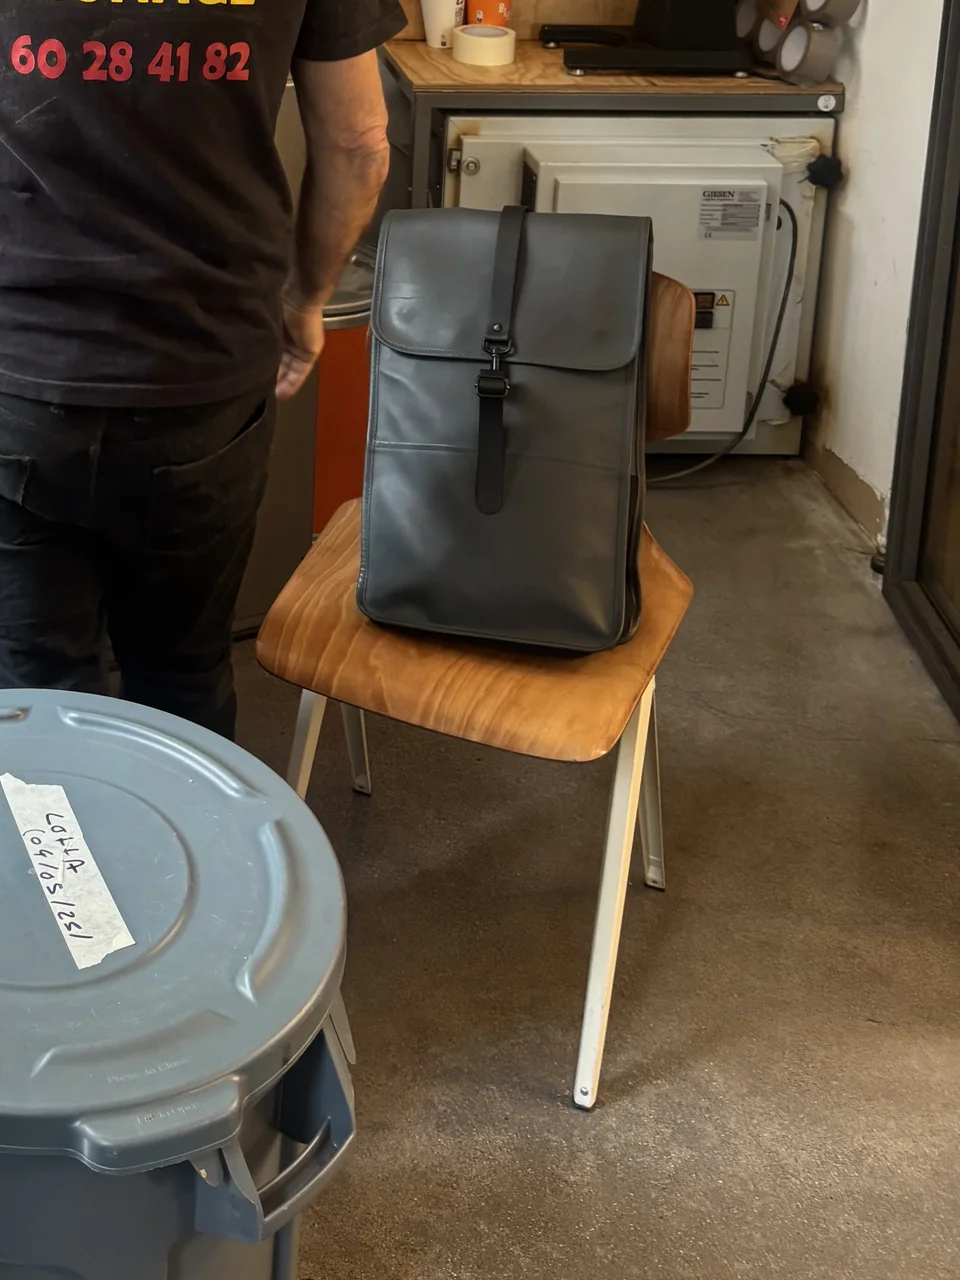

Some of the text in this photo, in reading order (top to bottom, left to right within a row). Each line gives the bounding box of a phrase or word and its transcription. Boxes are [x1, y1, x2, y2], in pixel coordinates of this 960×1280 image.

[11, 35, 67, 80] 60
[82, 41, 133, 82] 28
[148, 41, 190, 82] 41
[202, 41, 250, 81] 82
